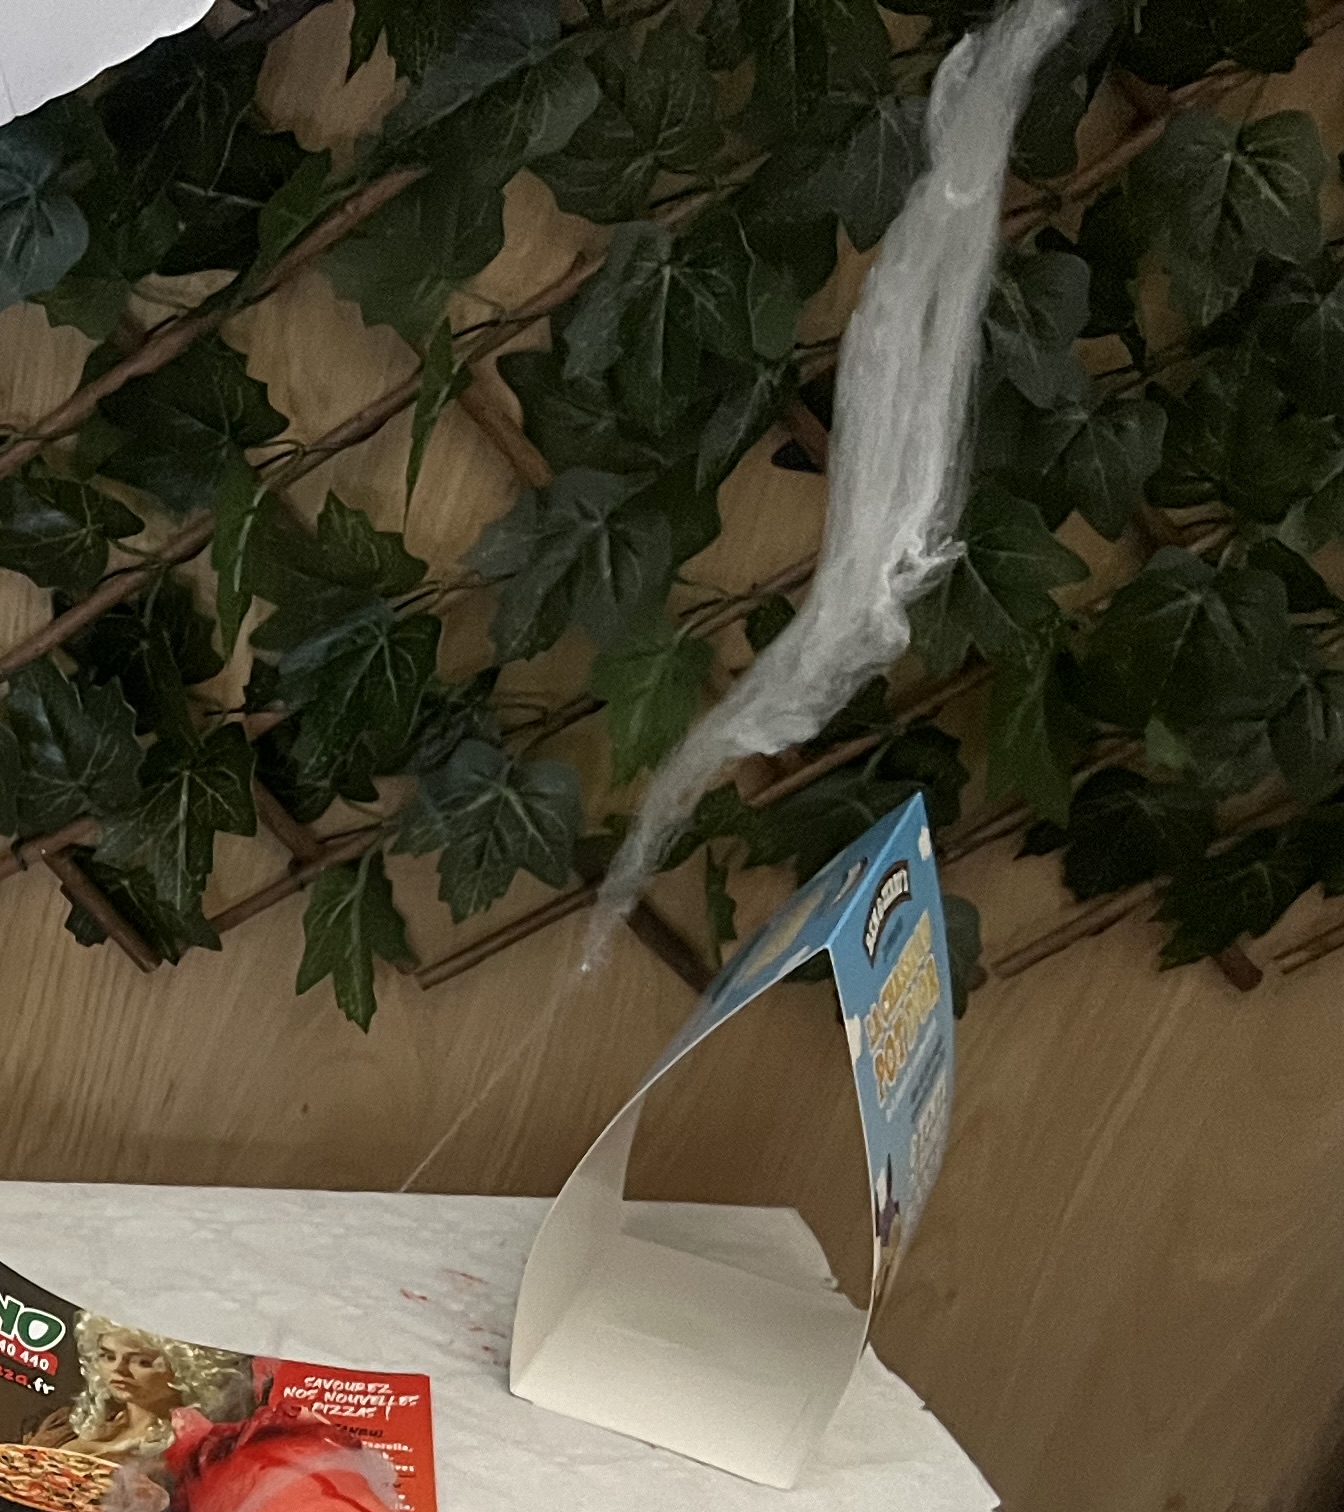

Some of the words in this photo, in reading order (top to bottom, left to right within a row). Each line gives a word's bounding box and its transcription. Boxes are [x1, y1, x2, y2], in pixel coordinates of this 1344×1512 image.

[20, 1352, 49, 1371] 440
[304, 1377, 393, 1394] SAVOUREZ
[284, 1387, 318, 1400] NOS
[324, 1392, 419, 1406] NOUVELLES
